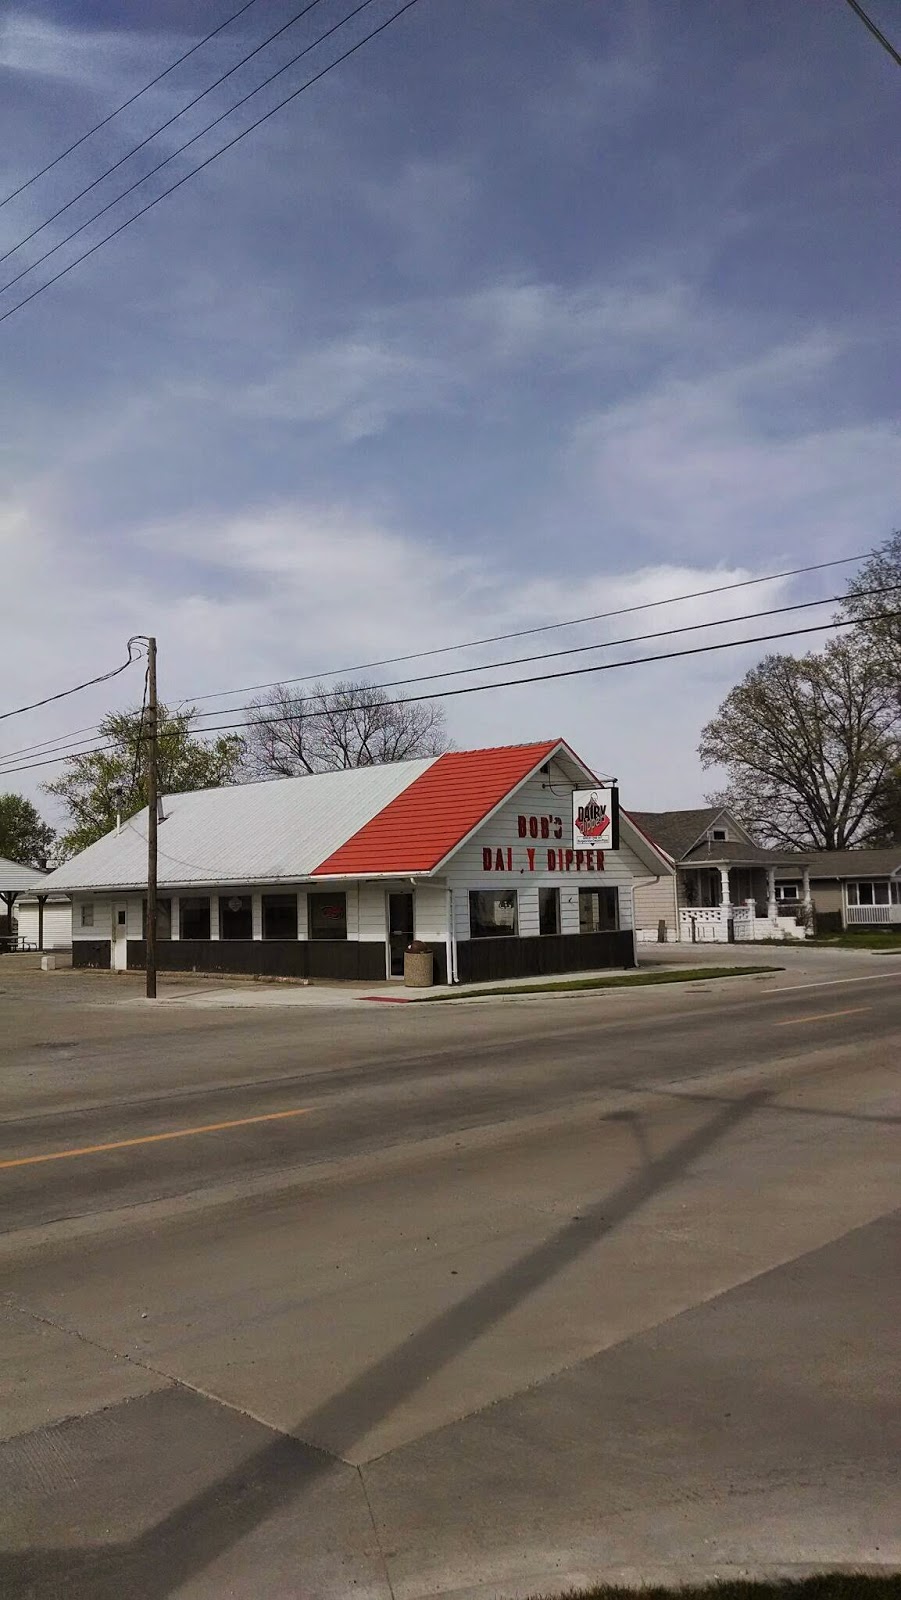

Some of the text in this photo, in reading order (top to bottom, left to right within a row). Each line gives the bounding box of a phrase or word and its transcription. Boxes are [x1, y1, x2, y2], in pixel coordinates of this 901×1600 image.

[578, 805, 606, 822] DAIRY
[518, 815, 562, 839] BOB'S
[547, 848, 604, 871] DIPPER
